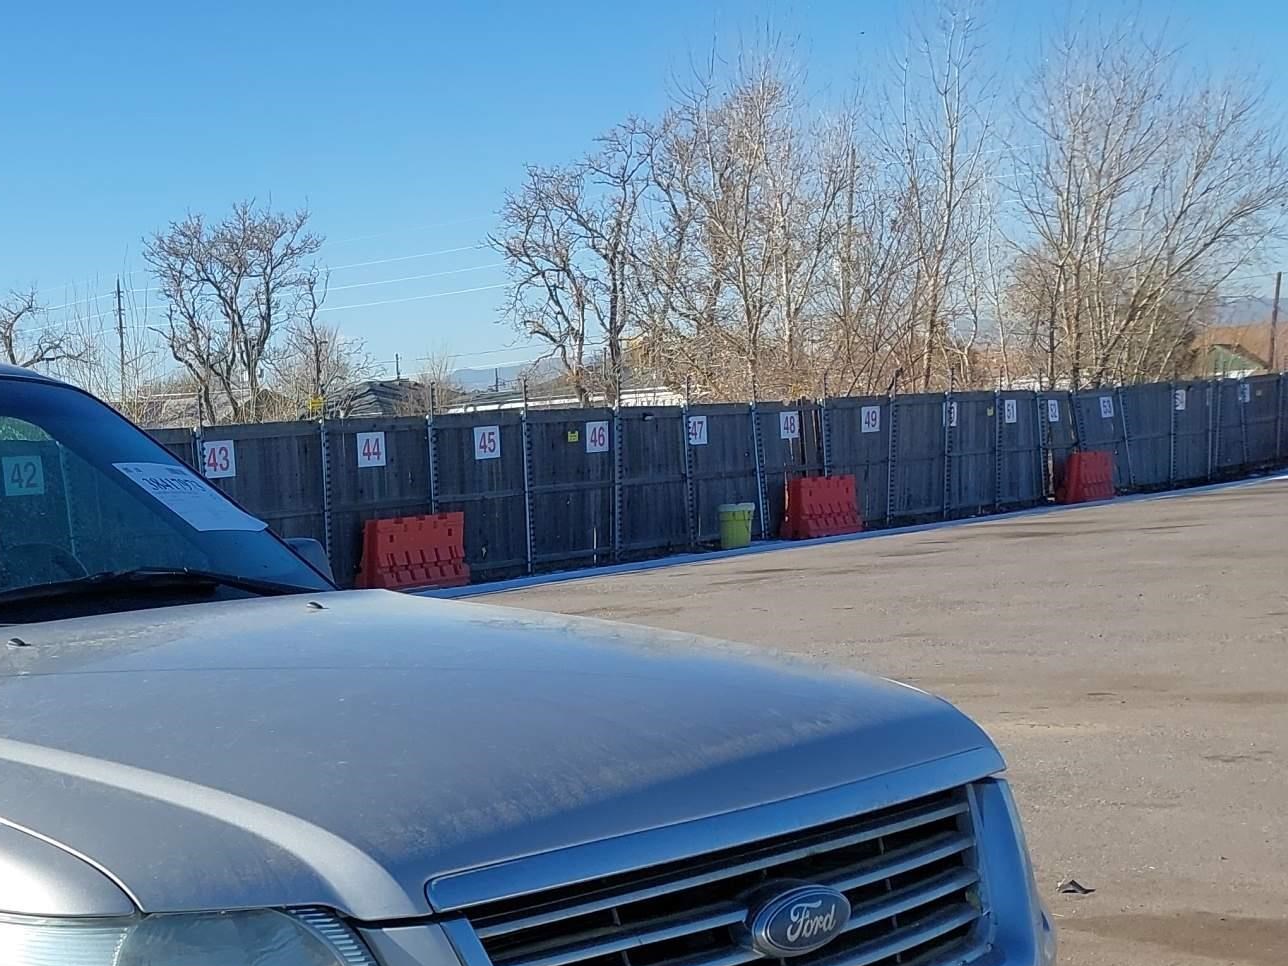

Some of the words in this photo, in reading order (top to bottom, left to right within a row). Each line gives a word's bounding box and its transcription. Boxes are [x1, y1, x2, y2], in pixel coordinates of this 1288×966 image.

[784, 415, 796, 433] 48
[864, 409, 877, 428] 49
[590, 426, 605, 447] 46
[691, 420, 704, 440] 47
[362, 437, 382, 461] 44
[479, 431, 496, 453] 45
[207, 446, 230, 472] 43
[11, 462, 40, 489] 42
[786, 899, 836, 942] Ford
